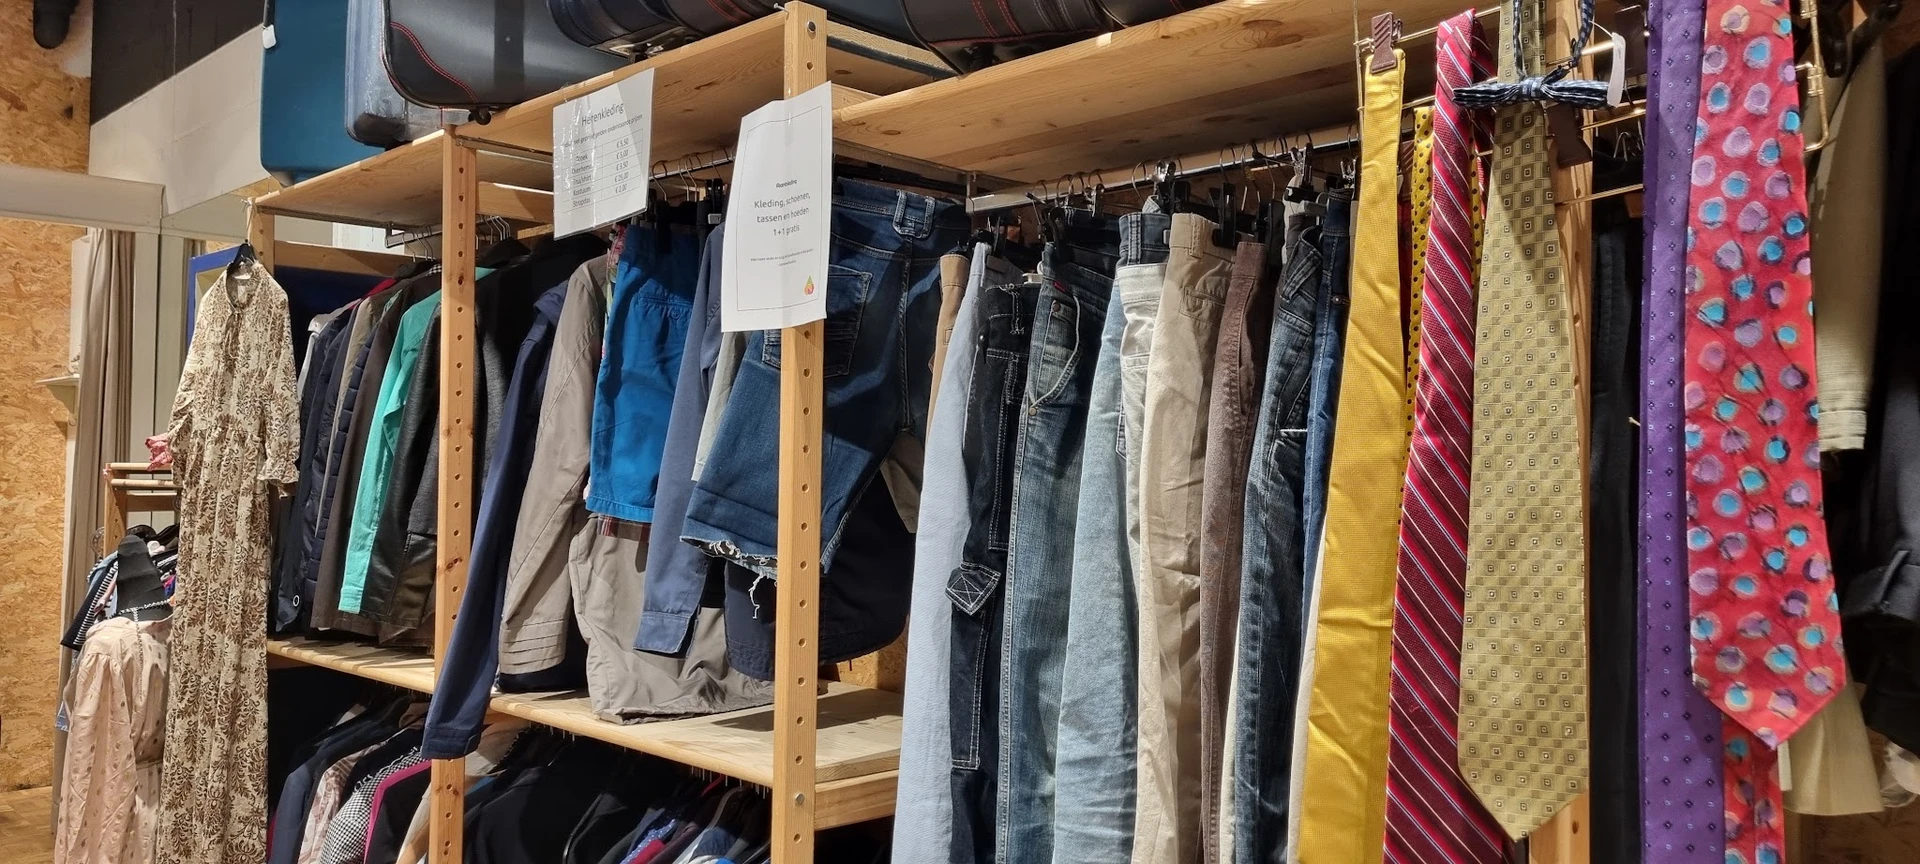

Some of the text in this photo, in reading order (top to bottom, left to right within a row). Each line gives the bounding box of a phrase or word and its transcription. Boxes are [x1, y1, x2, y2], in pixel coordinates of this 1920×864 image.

[582, 103, 624, 126] Herenkleding
[754, 192, 810, 208] Kleding, schoenen,
[757, 214, 783, 223] tassen
[790, 207, 809, 218] hoeden
[786, 224, 800, 236] gratis
